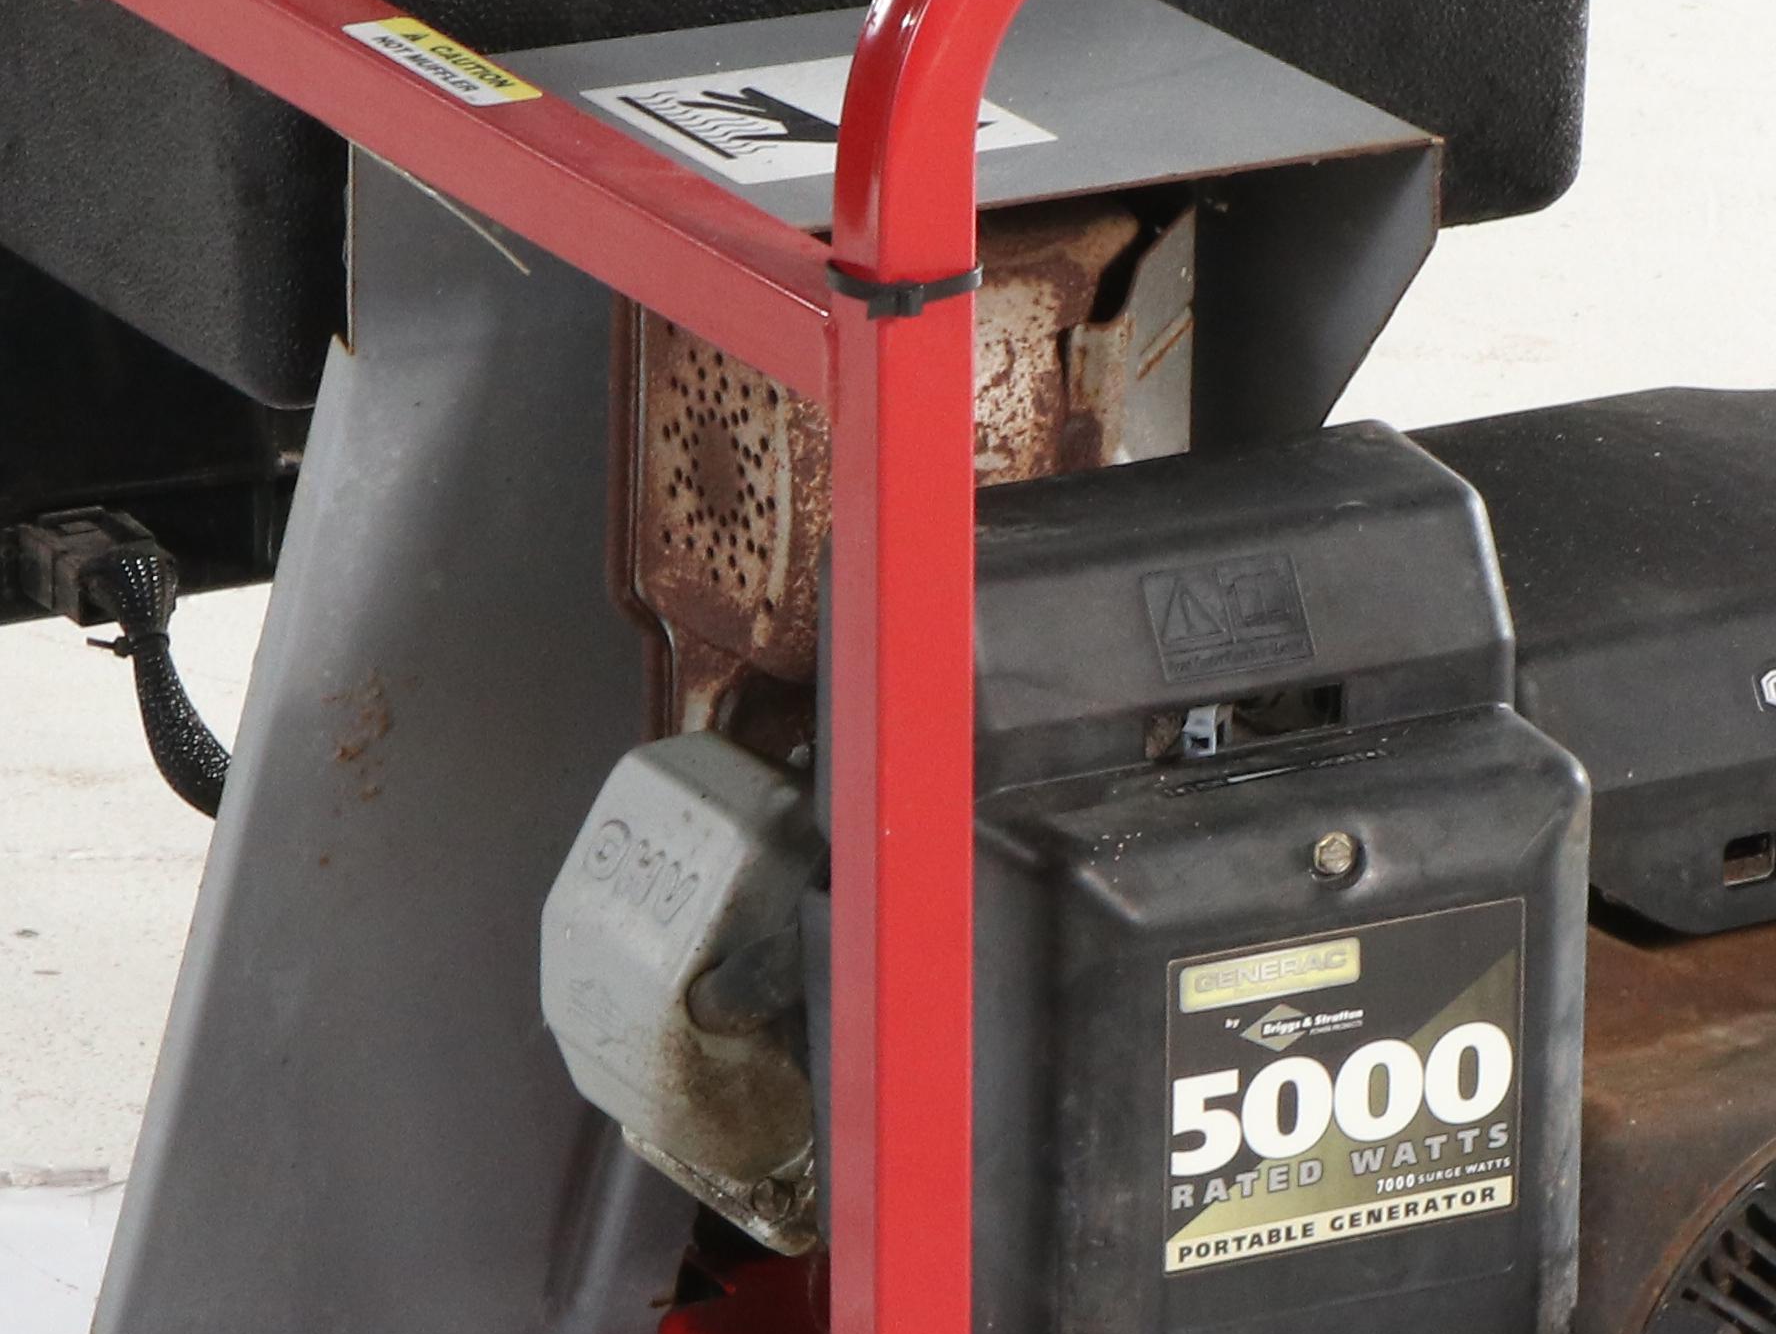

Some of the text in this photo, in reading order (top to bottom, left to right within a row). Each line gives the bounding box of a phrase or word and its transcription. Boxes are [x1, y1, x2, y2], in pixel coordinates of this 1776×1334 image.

[374, 35, 481, 93] HOT MUFFLER
[429, 45, 516, 88] CAUTION
[1194, 948, 1348, 994] GENERAC
[1225, 1009, 1364, 1036] by Briggs & Stratton
[1171, 1021, 1513, 1177] 5000
[1171, 1122, 1509, 1211] RATED WATTS
[1376, 1156, 1511, 1195] 7000 SURGE WATTS
[1178, 1186, 1496, 1263] PORTABLE GENERATOR
